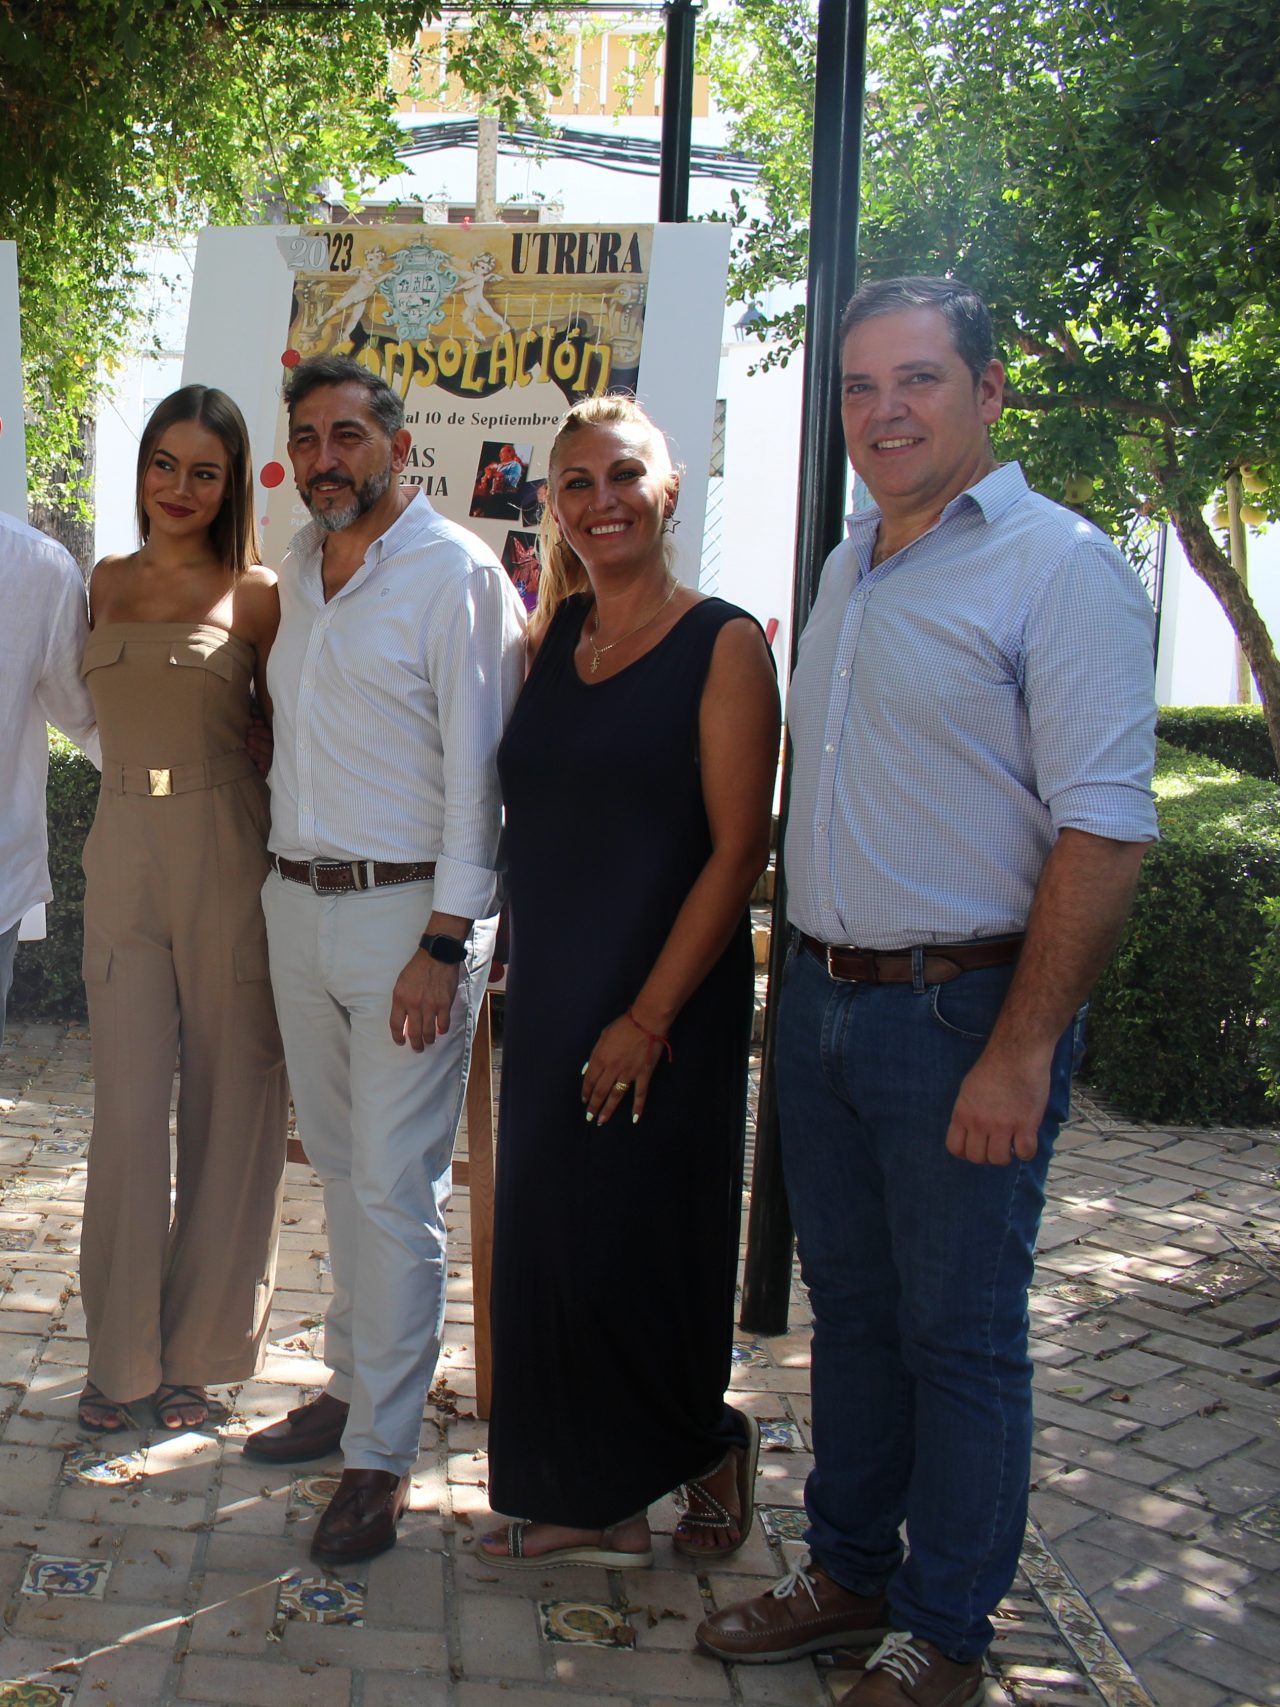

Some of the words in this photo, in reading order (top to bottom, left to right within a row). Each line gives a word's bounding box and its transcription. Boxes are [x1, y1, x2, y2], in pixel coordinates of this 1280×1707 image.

[510, 231, 644, 275] UTRERA
[405, 411, 420, 424] al
[424, 411, 442, 425] 10
[446, 412, 466, 426] de
[470, 412, 559, 430] Septiembre
